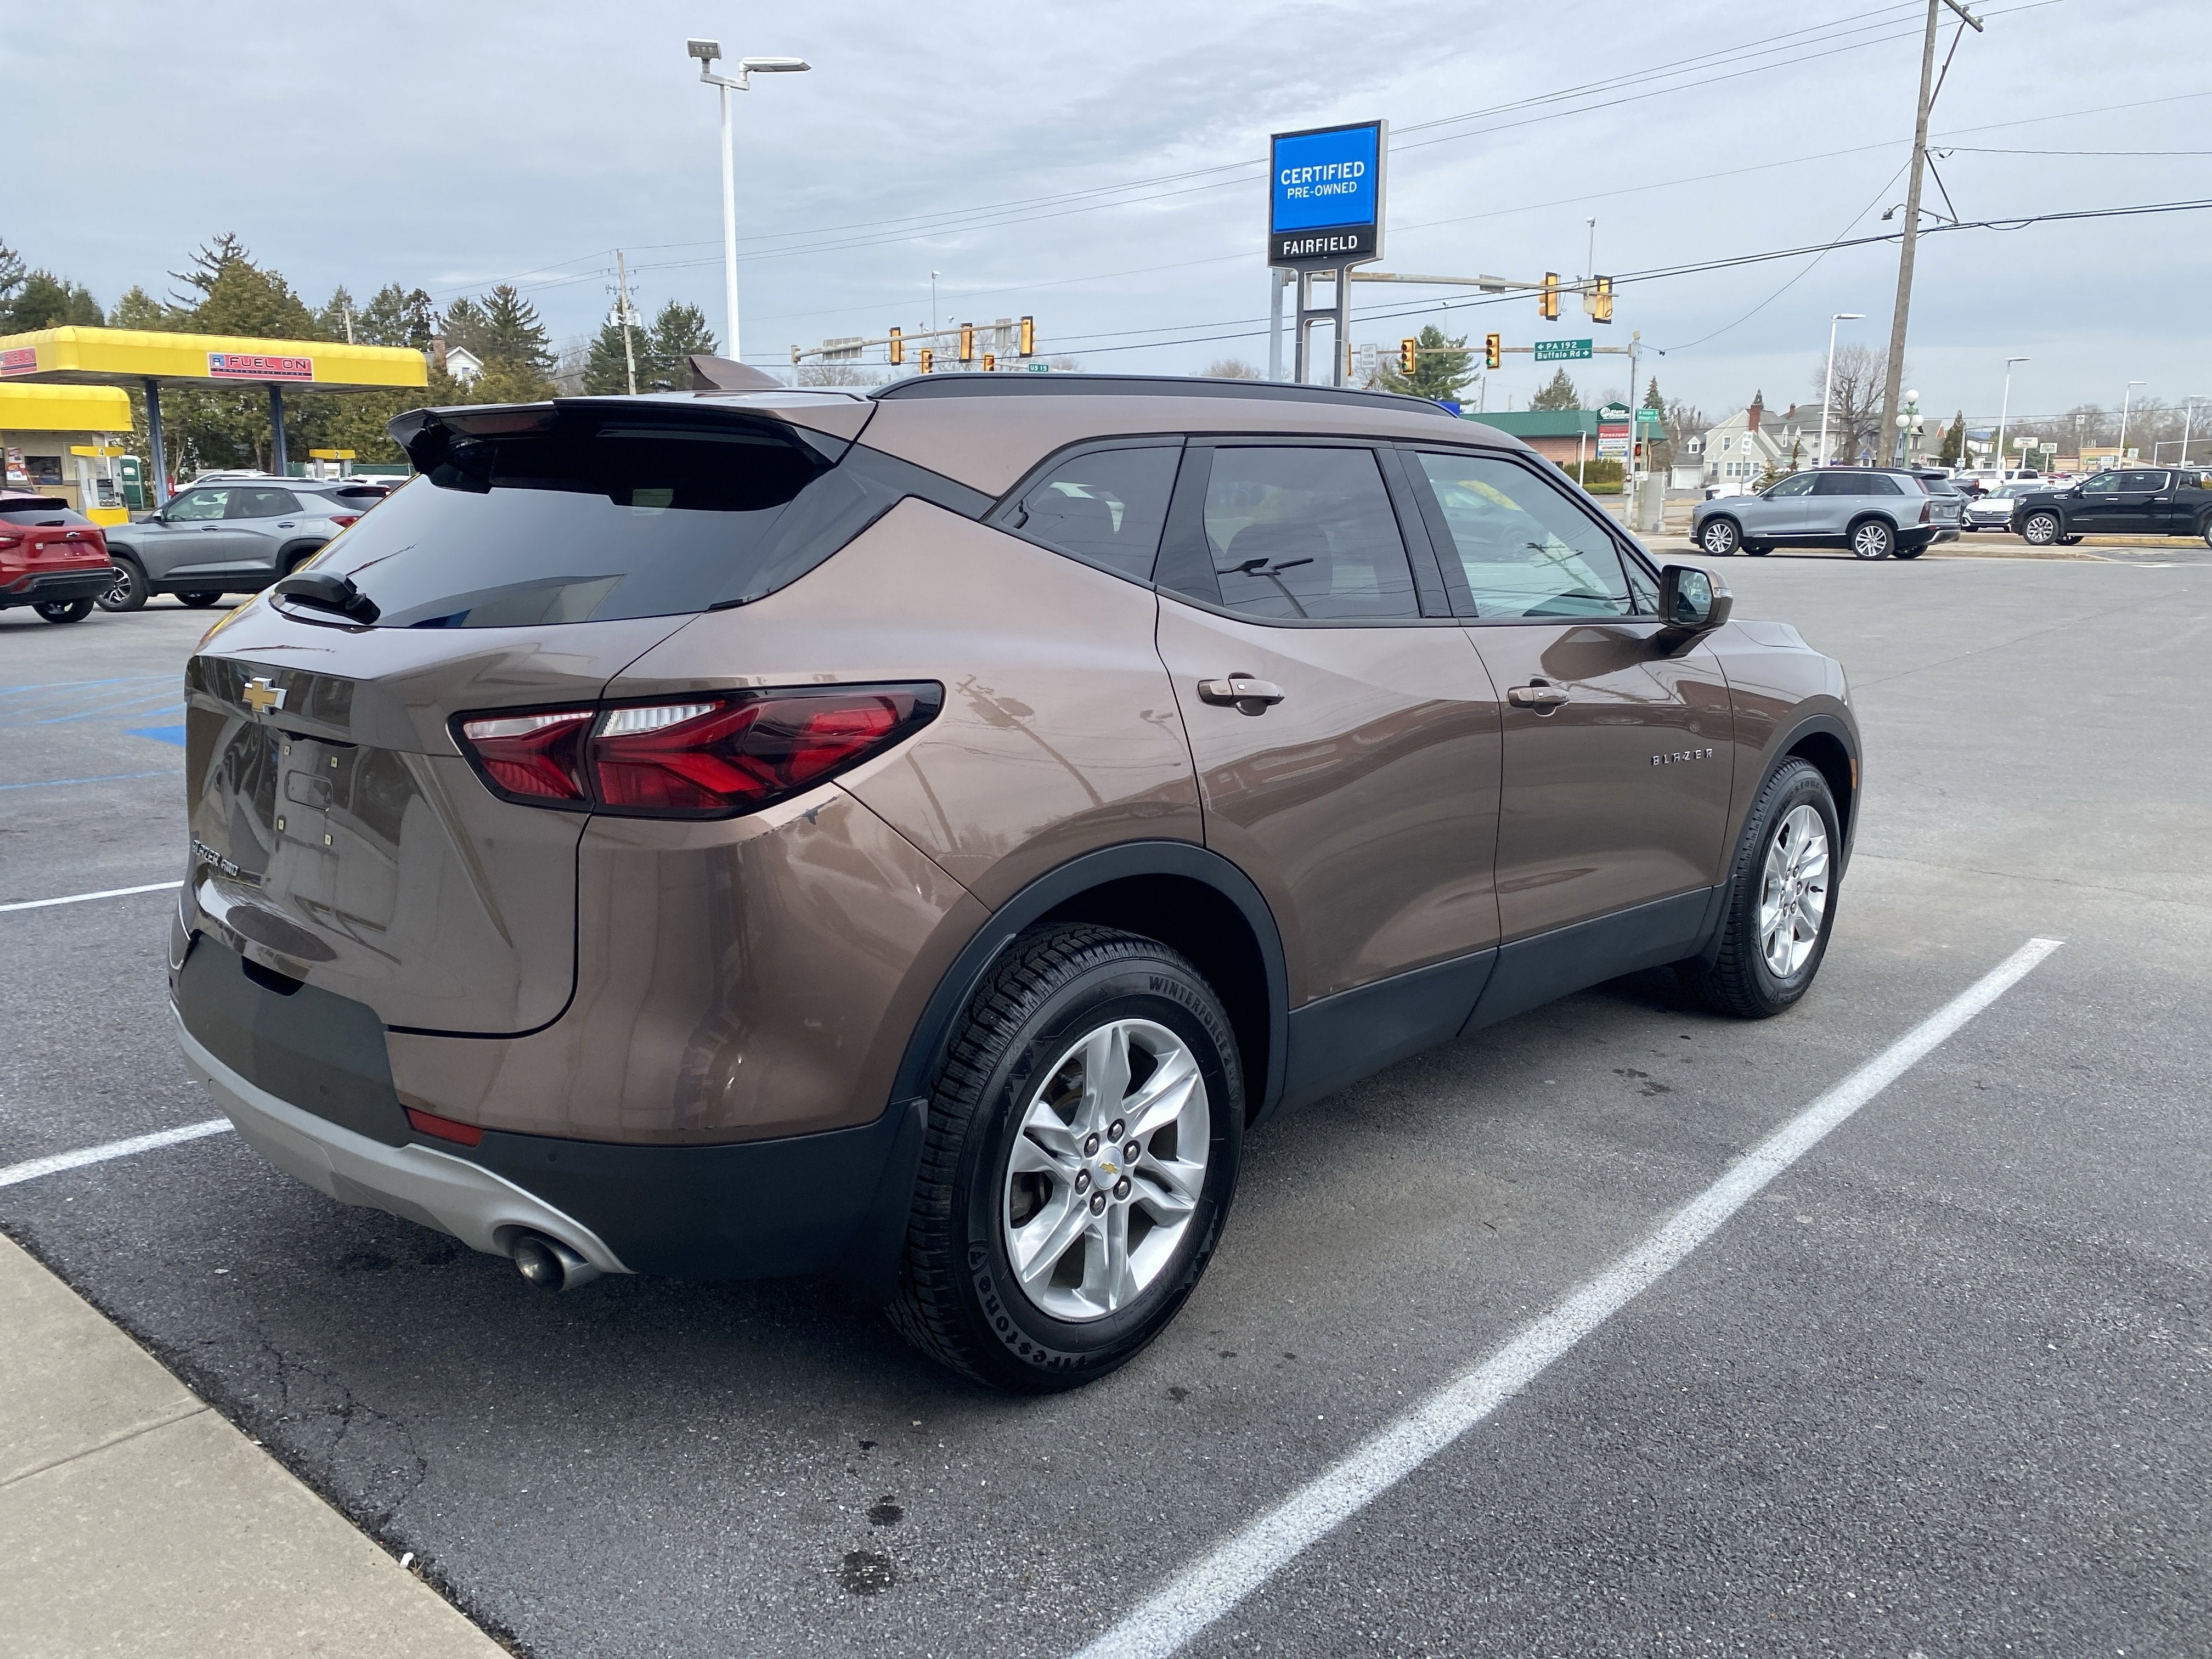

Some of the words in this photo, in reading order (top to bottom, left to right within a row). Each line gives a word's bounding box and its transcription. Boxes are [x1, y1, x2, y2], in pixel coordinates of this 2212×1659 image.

[1280, 161, 1365, 185] CERTIFIED
[1287, 181, 1357, 200] PRE-OWNED
[1283, 235, 1358, 255] FAIRFIELD
[1561, 341, 1577, 349] 192
[229, 357, 275, 368] FUEL
[283, 359, 306, 369] ON
[1537, 351, 1567, 359] Buffalo
[1650, 747, 1713, 766] BLAZER
[192, 839, 222, 867] BLAZER
[221, 859, 240, 877] AWD
[1149, 975, 1228, 1054] WINTERFORCE
[978, 1275, 1088, 1368] Firestone
